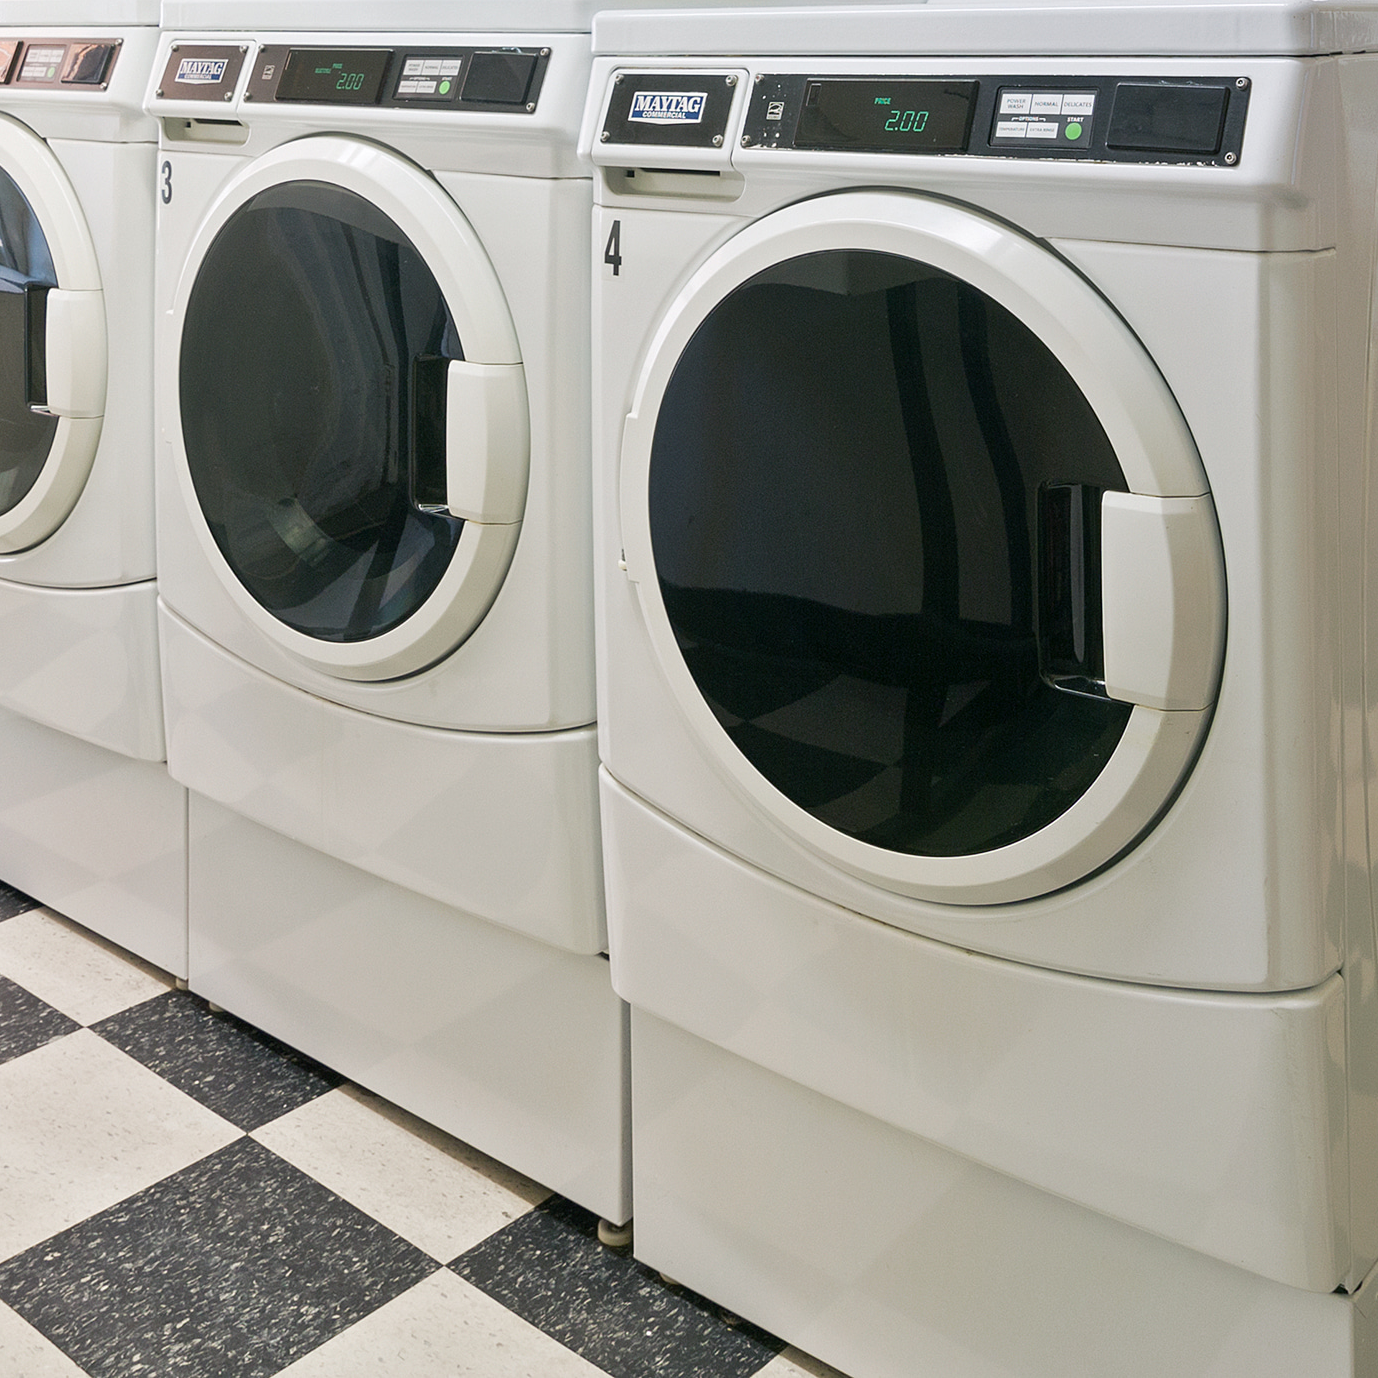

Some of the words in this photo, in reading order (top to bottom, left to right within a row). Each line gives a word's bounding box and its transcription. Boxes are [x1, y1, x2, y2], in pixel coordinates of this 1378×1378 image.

[180, 62, 223, 75] MAYTAG
[336, 73, 365, 90] 2.00
[634, 95, 701, 113] MAYTAG
[642, 111, 686, 119] COMMERCIAL
[884, 110, 929, 132] 2.00
[161, 160, 172, 204] 3
[604, 219, 622, 276] 4
